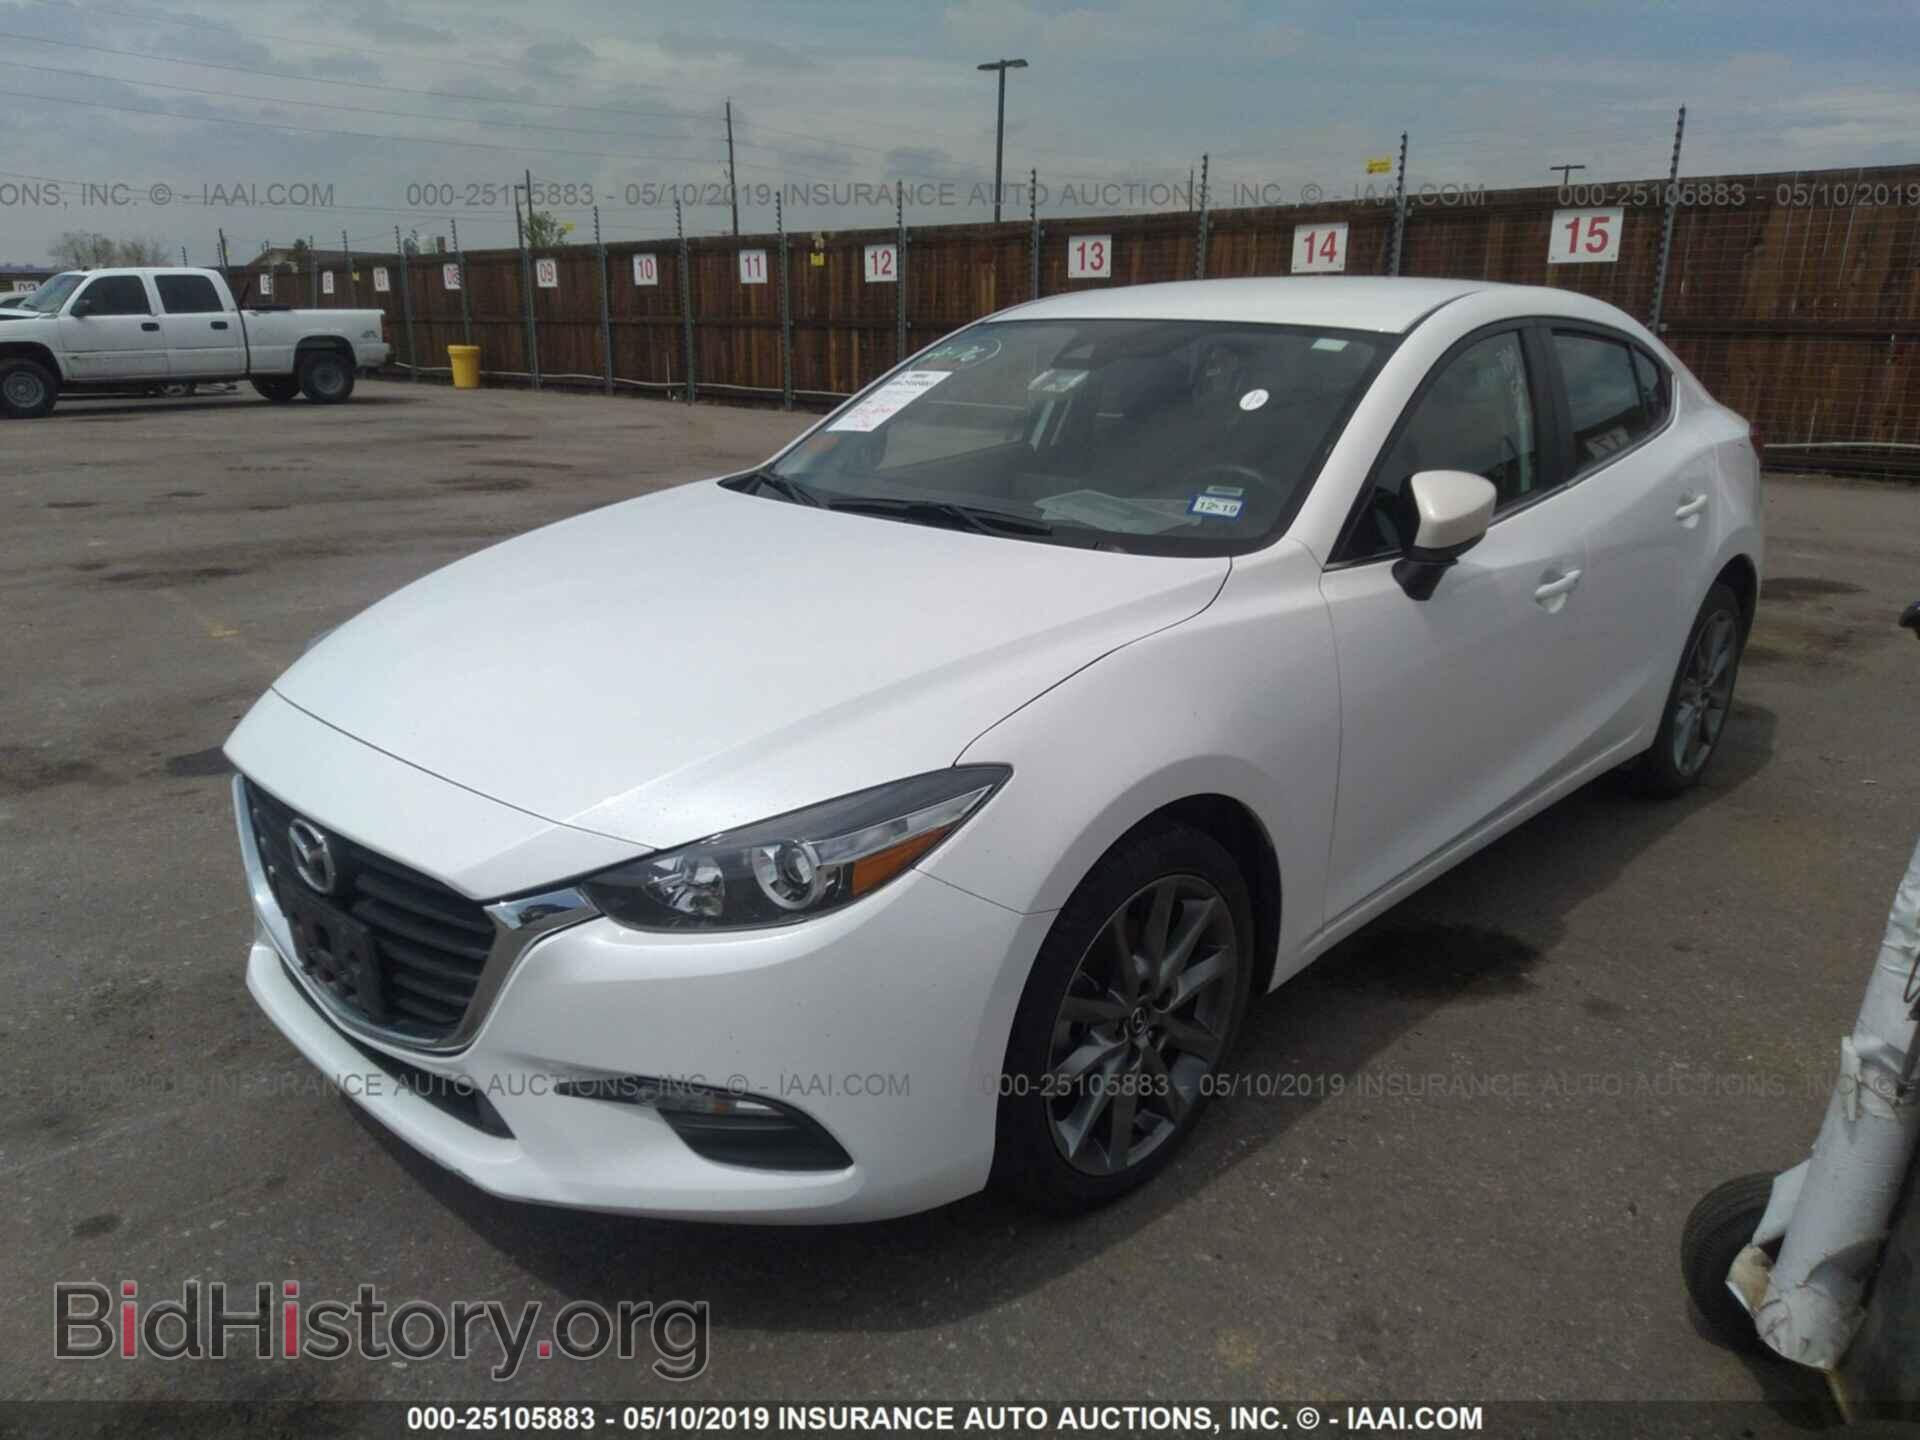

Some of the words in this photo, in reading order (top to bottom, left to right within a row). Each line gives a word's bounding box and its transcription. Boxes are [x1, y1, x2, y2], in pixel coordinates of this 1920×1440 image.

[1565, 216, 1610, 254] 15
[1077, 241, 1104, 271] 13
[1304, 231, 1337, 264] 14
[540, 262, 554, 282] 09
[638, 258, 654, 279] 10
[745, 255, 761, 278] 11
[871, 250, 892, 275] 12
[1200, 500, 1238, 513] 12-19
